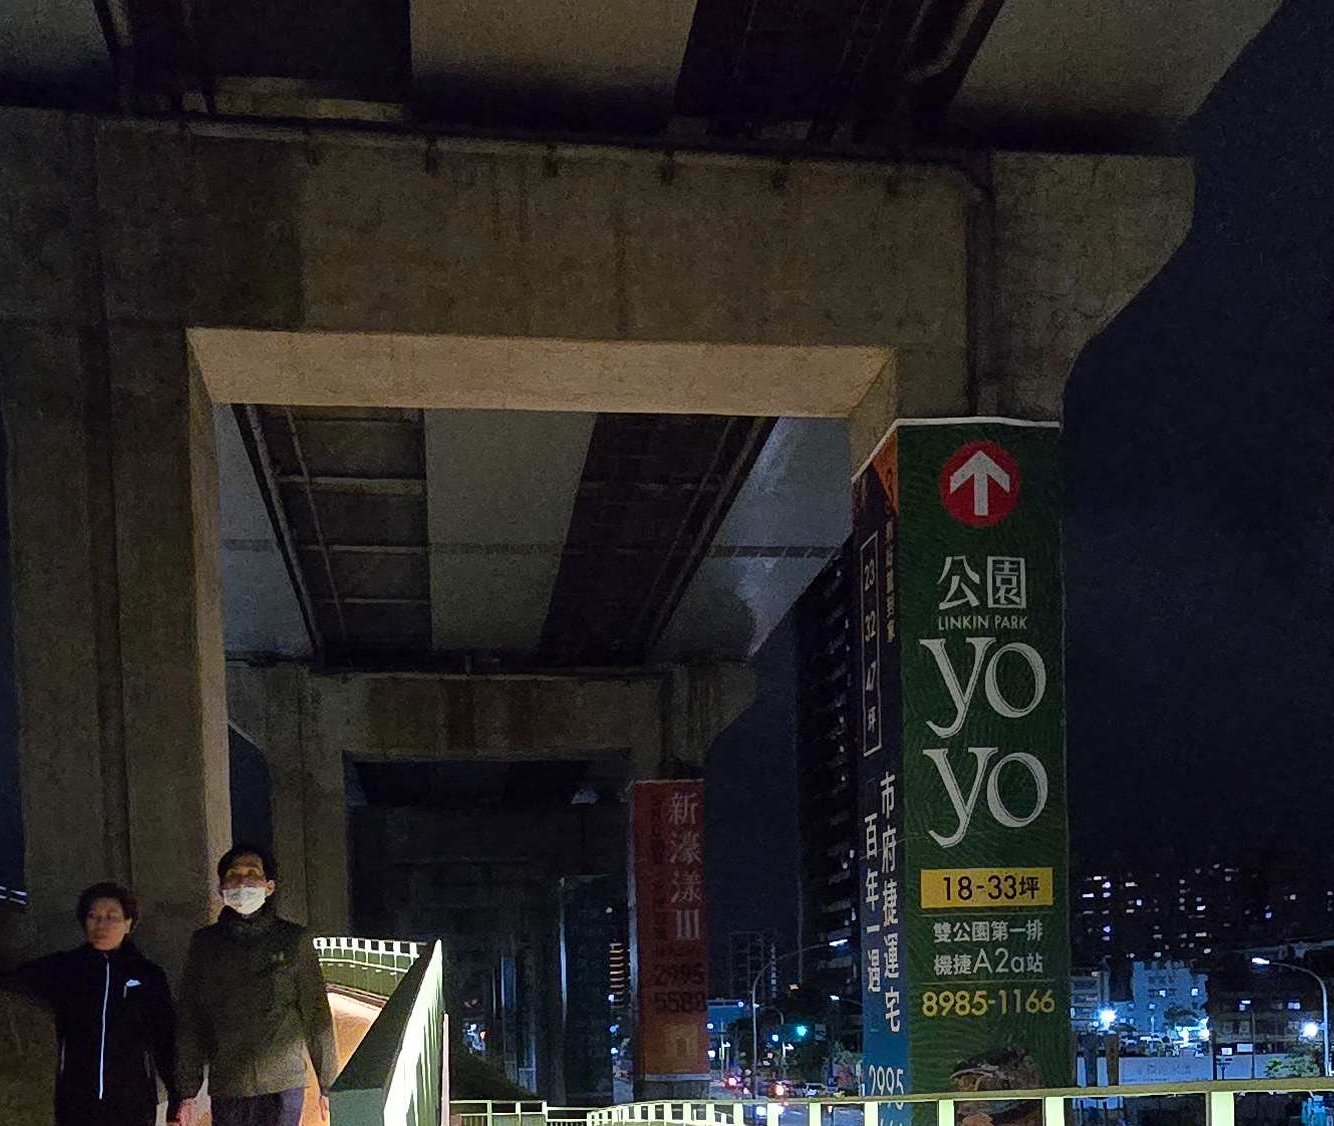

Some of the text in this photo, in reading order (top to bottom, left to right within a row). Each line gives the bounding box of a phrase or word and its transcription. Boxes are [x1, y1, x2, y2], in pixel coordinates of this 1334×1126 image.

[937, 555, 1027, 610] 公園
[938, 615, 1028, 631] LINKIN PARK
[919, 636, 1047, 739] yo
[923, 746, 1049, 849] yo
[864, 812, 882, 993] 百年一遇
[880, 771, 901, 1033] 市府捷運宅
[943, 874, 1041, 902] 18-33坪
[932, 919, 1043, 944] 雙公園第一排
[933, 947, 1044, 976] 機捷A2a站
[922, 989, 1055, 1017] 8985-1166
